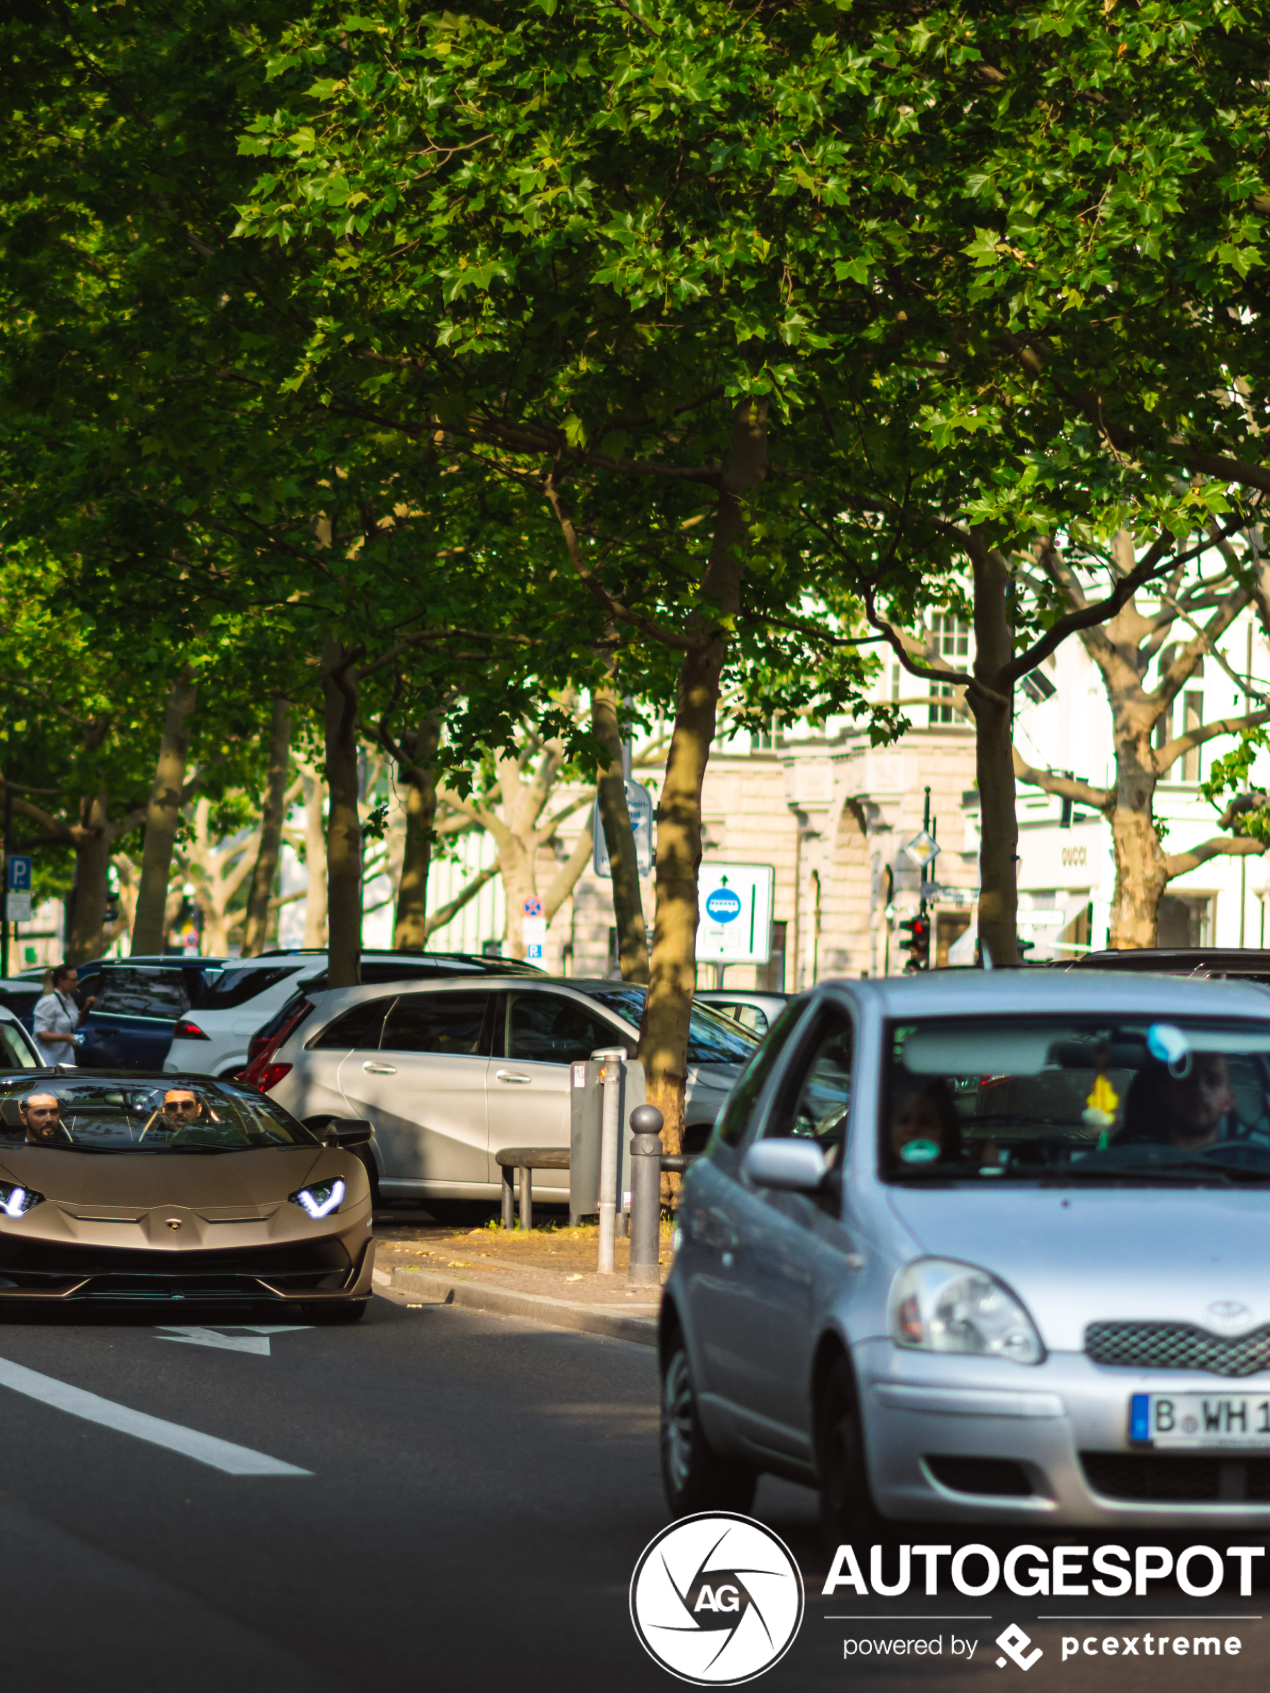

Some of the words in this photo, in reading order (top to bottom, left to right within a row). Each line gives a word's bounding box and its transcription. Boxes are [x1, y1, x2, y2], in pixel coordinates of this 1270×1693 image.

[1061, 846, 1088, 867] GUCCI
[14, 860, 27, 885] P
[1155, 1398, 1176, 1433] B
[1201, 1400, 1247, 1433] WH
